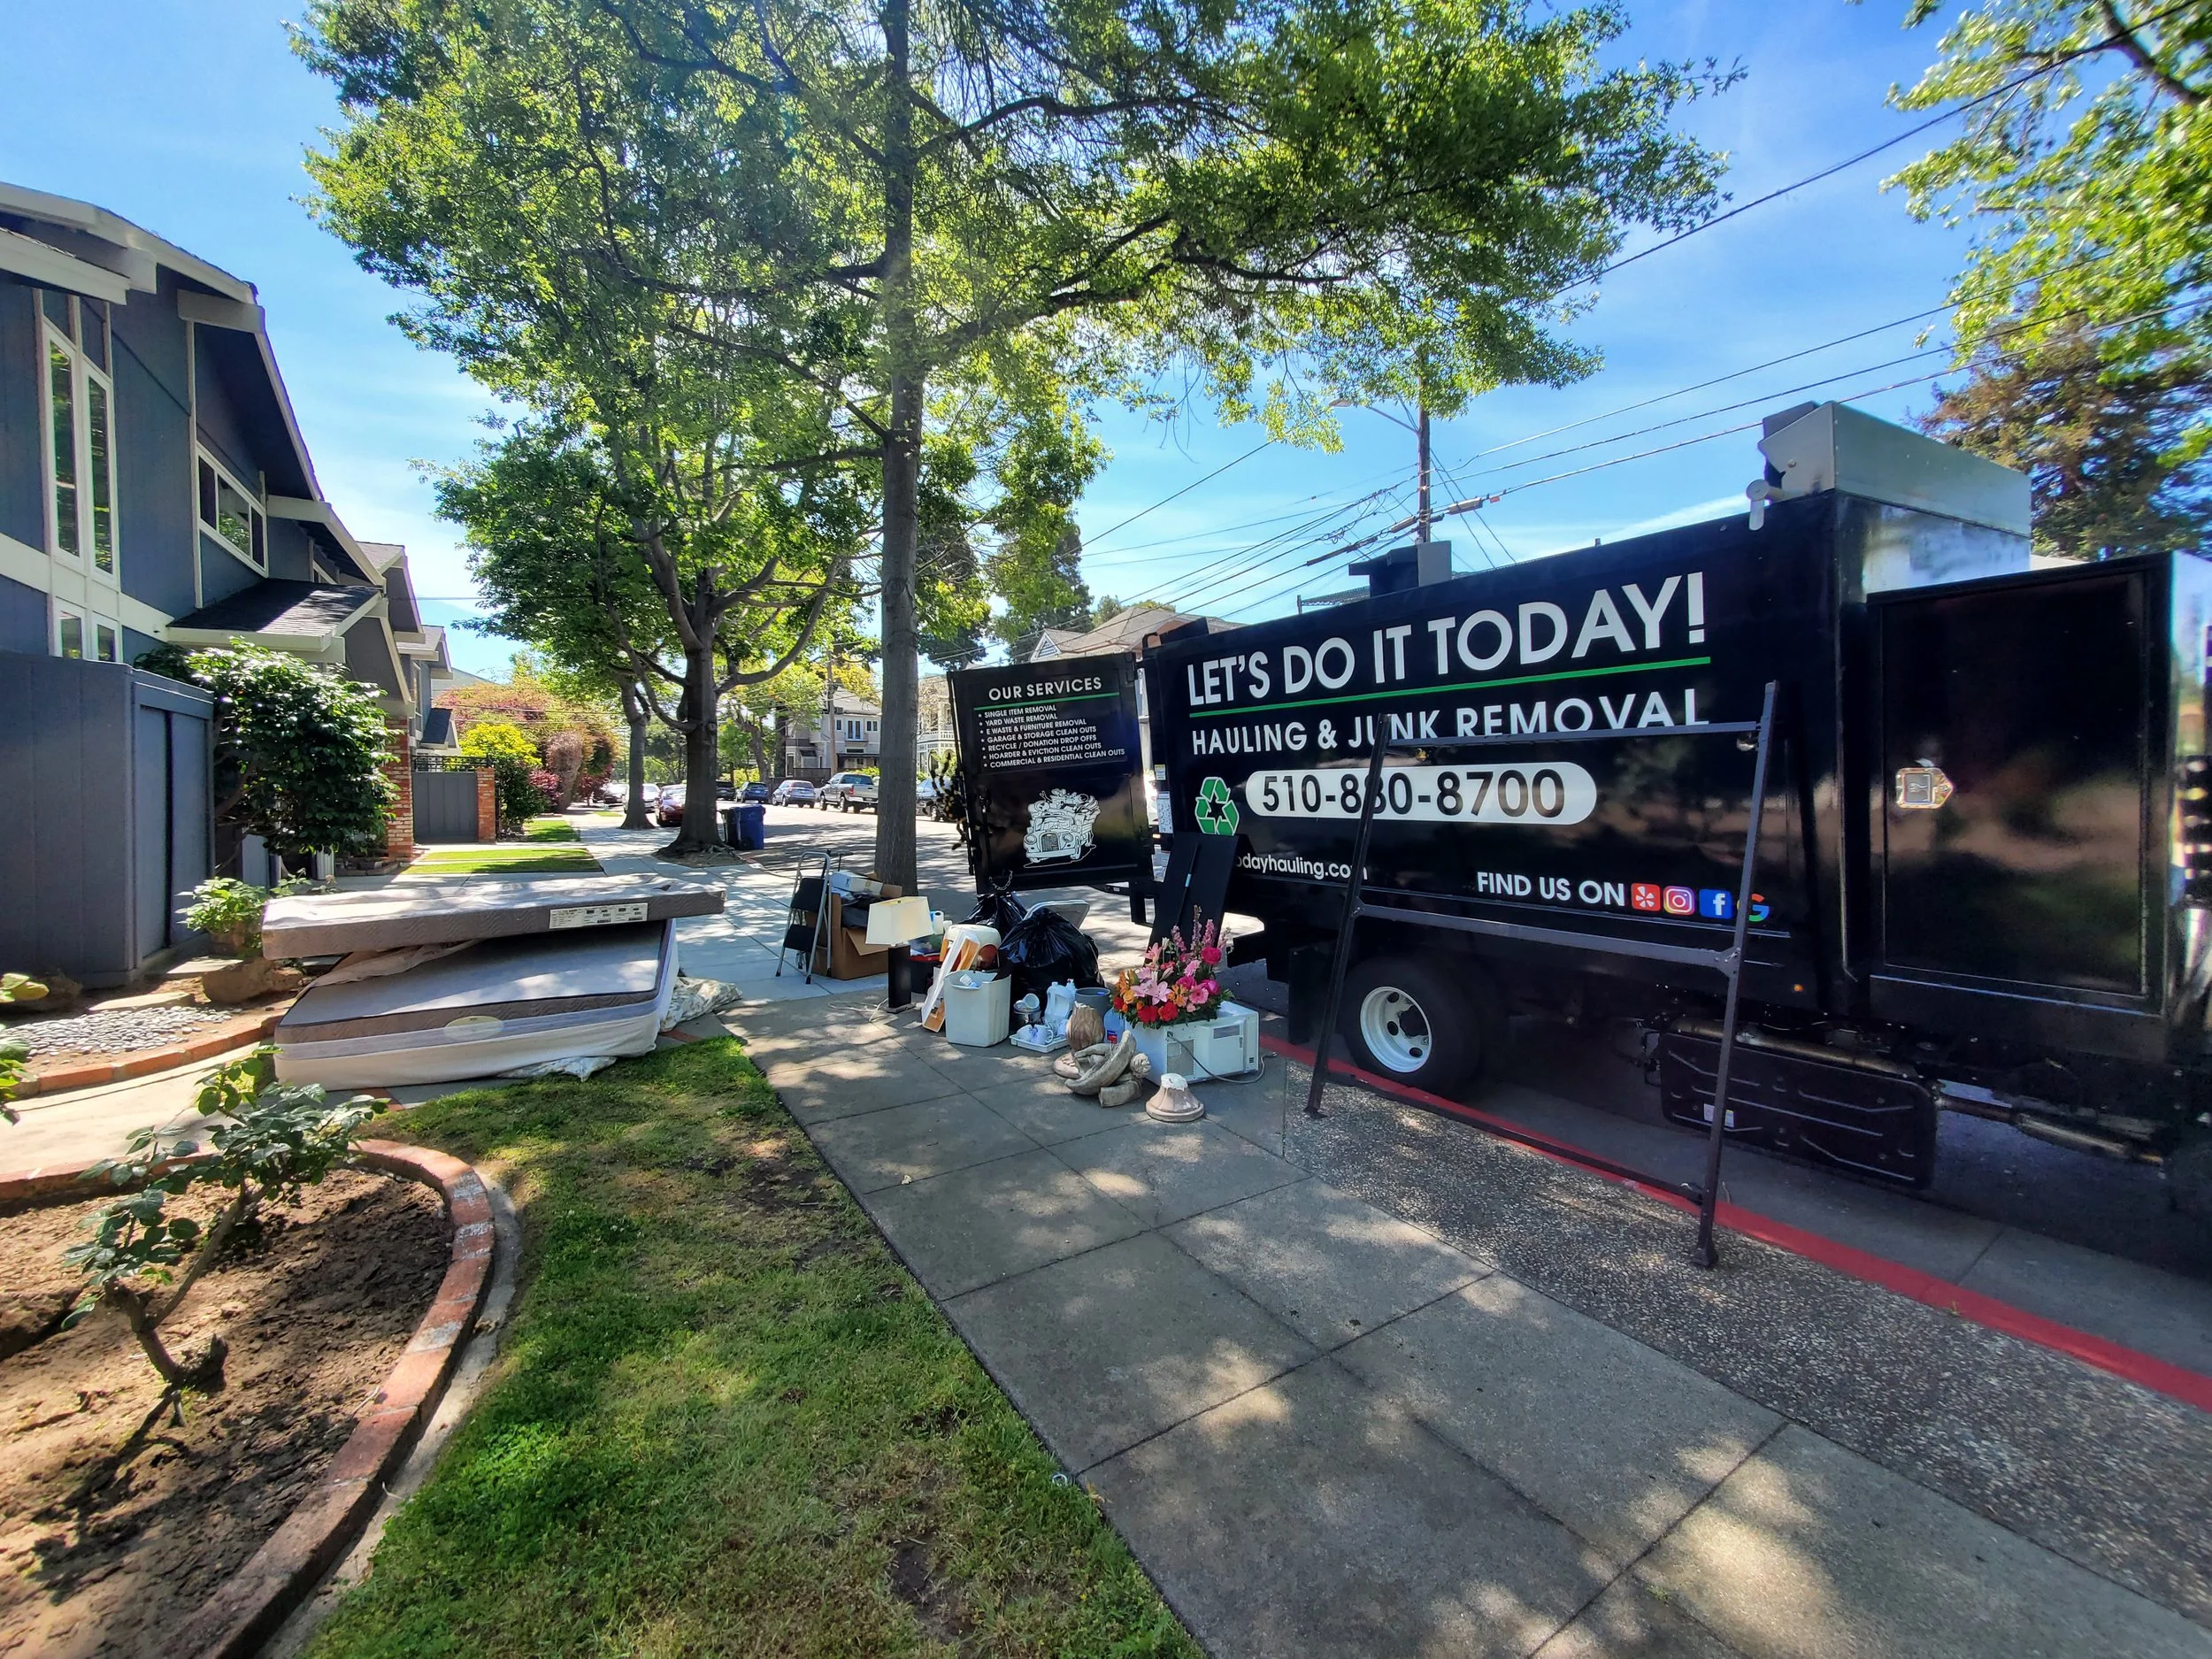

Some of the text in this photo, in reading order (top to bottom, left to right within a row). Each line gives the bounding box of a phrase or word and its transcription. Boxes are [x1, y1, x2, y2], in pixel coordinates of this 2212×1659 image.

[1187, 571, 1706, 706] LET'S DO IT TODAY!
[988, 676, 1102, 701] OUR SERVICES
[984, 710, 1008, 718] SINGLE
[1025, 704, 1057, 715] REMOVAL
[985, 713, 1058, 726] YARD WASTE REMOVAL
[991, 726, 1013, 734] WASTE
[1019, 721, 1054, 732] FURNITURE
[1055, 718, 1087, 728] REMOVAL
[1191, 718, 1308, 757] HAULING
[1317, 714, 1339, 750] &
[1456, 688, 1709, 737] REMOVAL
[987, 734, 1017, 743] GARAGE
[1023, 730, 1055, 740] STORAGE
[1055, 727, 1079, 736] CLEAN
[987, 742, 1018, 752] RECYCLE
[1023, 738, 1059, 748] DONATION
[1079, 733, 1097, 742] OFFS
[988, 750, 1021, 760] HOARDER
[1028, 747, 1060, 756] EVICTION
[1060, 744, 1084, 753] CLEAN
[1084, 741, 1102, 750] OUTS
[989, 757, 1036, 768] COMMERCIAL
[1042, 753, 1084, 763] RESIDENTIAL
[1084, 749, 1107, 759] CLEAN
[1107, 748, 1125, 757] OUTS
[1477, 871, 1532, 896] FIND
[1539, 876, 1571, 901] US
[1578, 879, 1625, 907] ON
